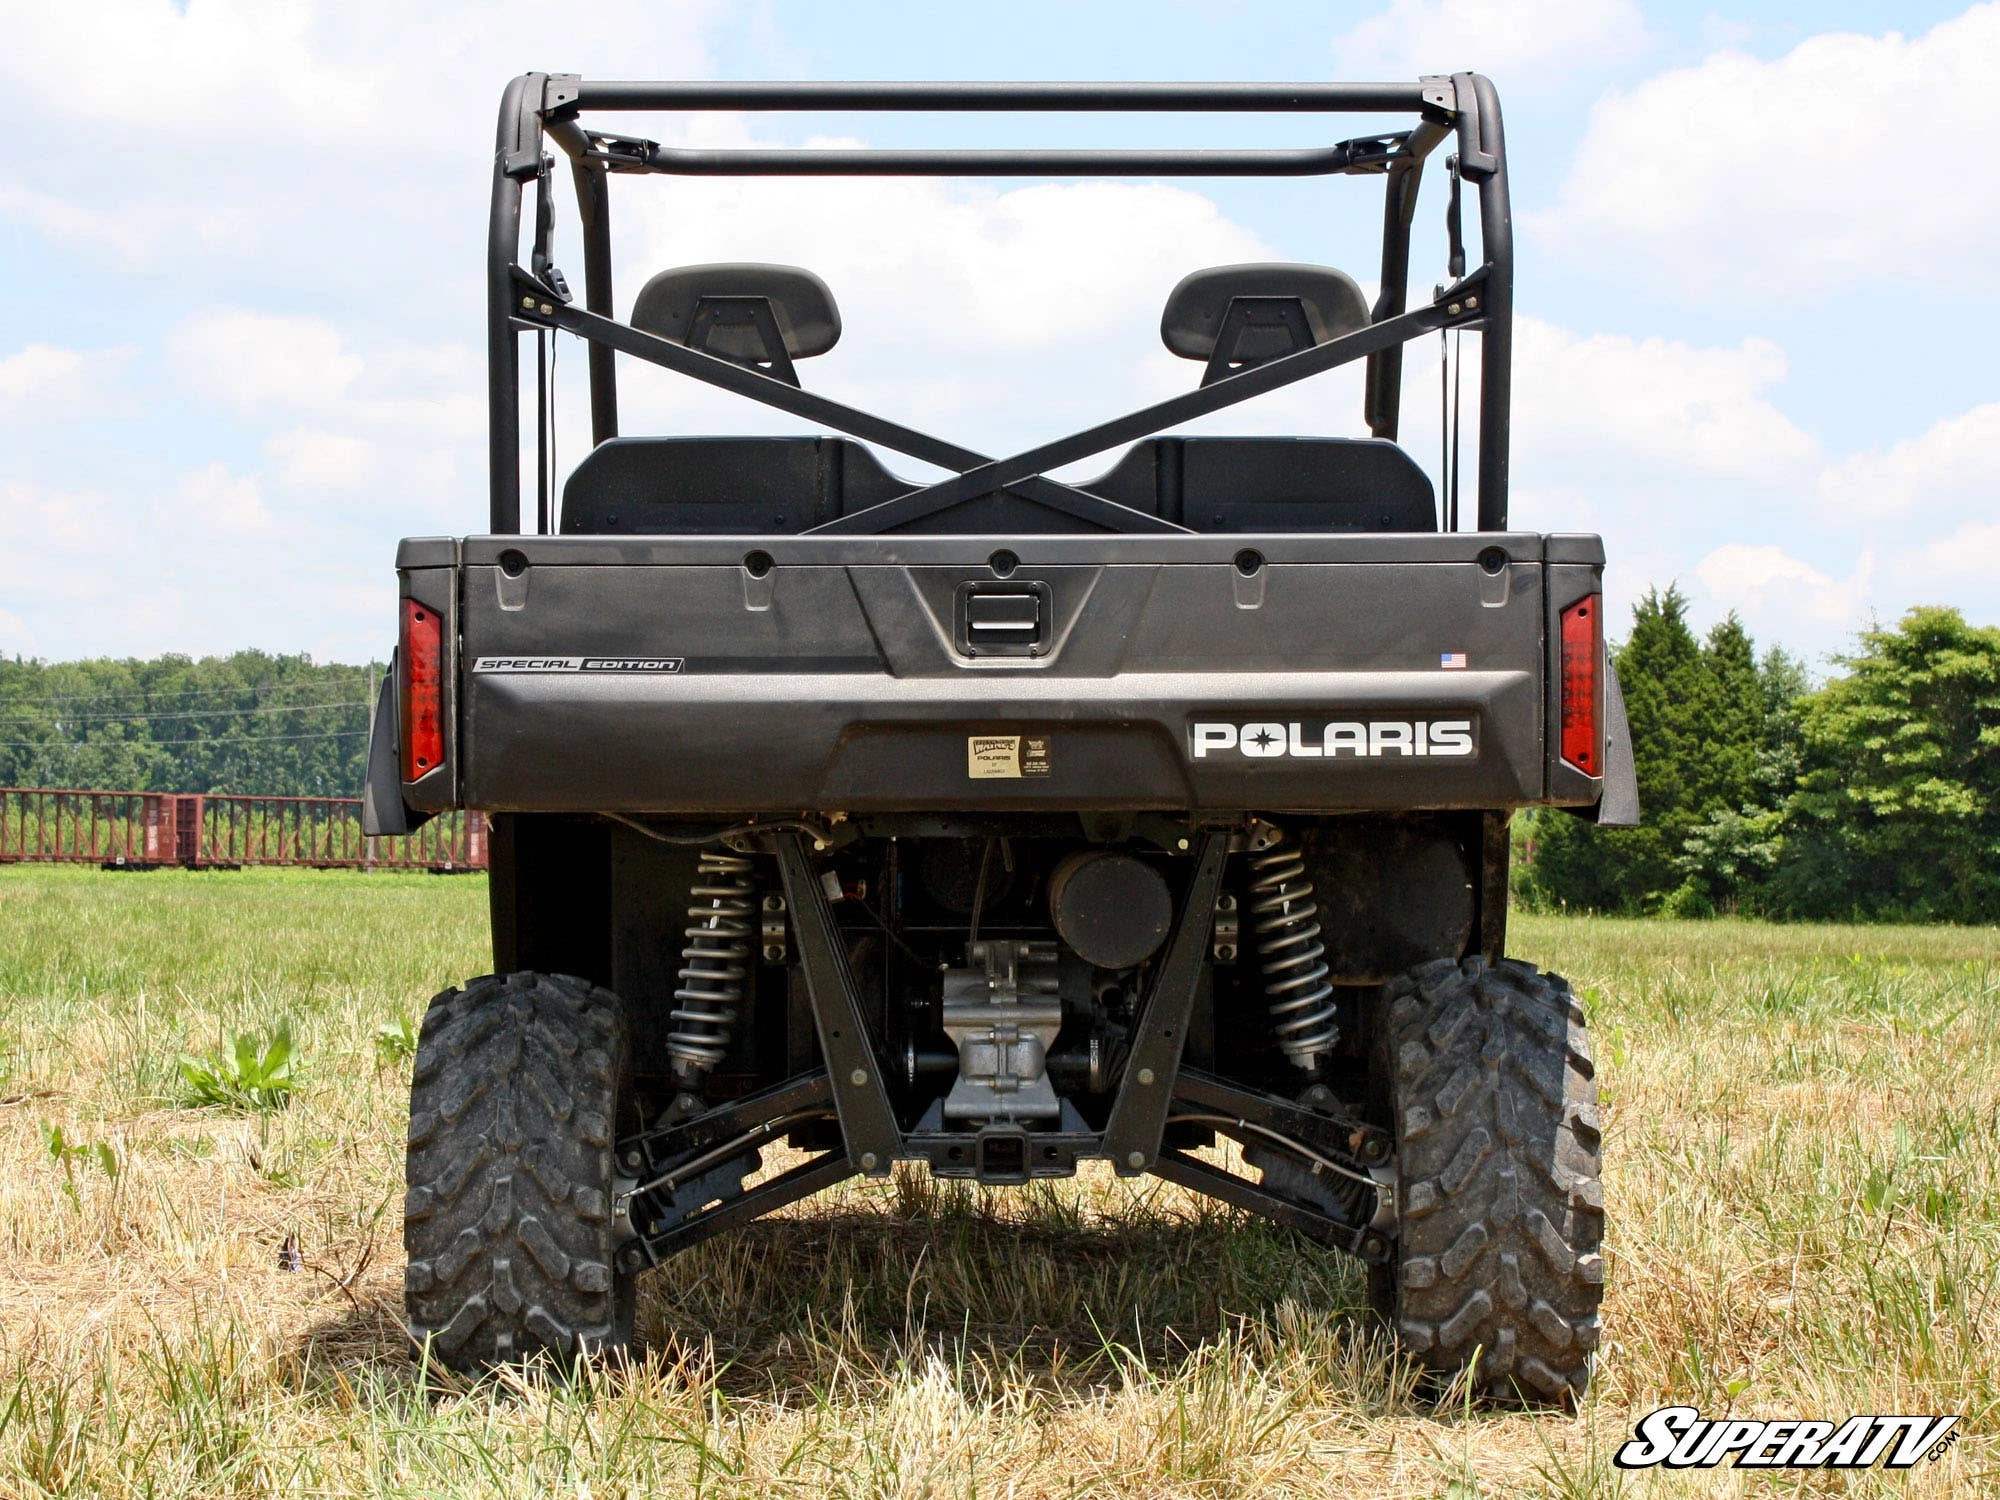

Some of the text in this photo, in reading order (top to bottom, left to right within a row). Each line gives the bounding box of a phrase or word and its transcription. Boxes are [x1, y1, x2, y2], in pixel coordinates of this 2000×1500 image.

[479, 659, 675, 670] SPECIAL EDITION
[1194, 720, 1473, 758] POLARIS
